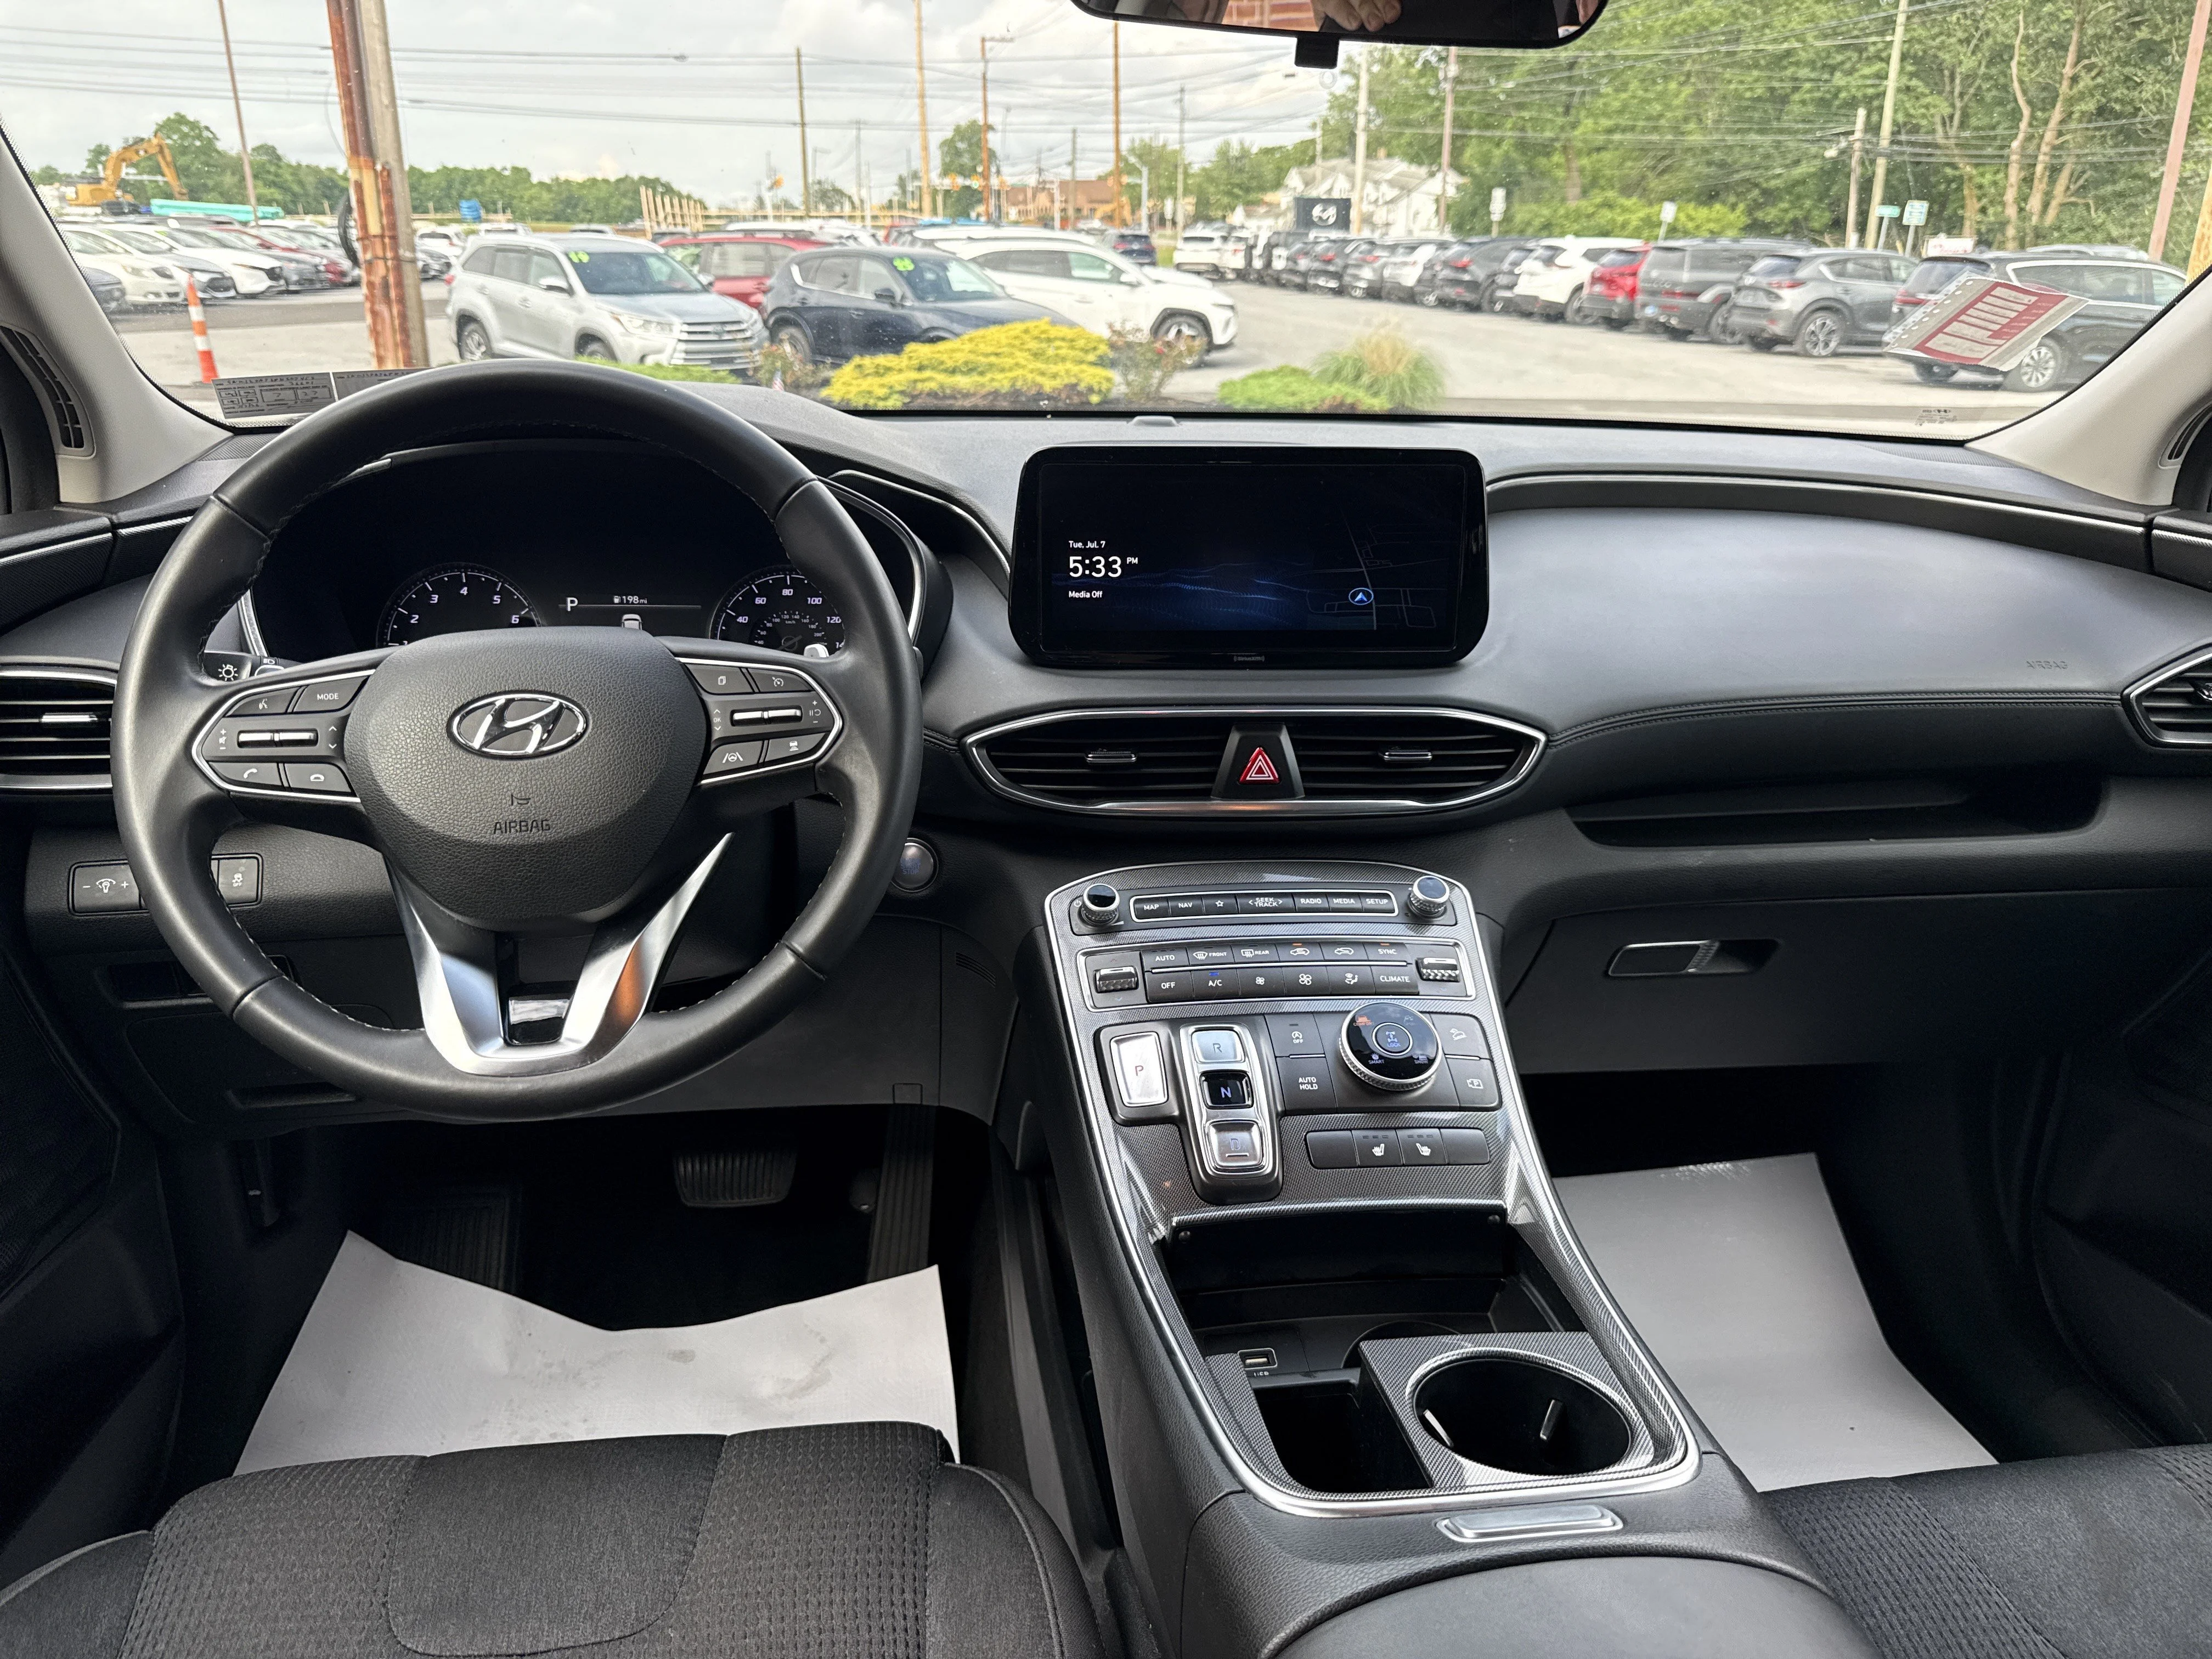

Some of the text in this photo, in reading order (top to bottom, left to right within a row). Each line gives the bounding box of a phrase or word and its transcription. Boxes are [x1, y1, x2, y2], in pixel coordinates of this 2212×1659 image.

[1068, 540, 1085, 549] Tue,
[1069, 556, 1122, 578] 5:33
[460, 586, 468, 595] 4
[430, 594, 438, 603] 3
[493, 595, 501, 604] 5
[567, 597, 578, 612] P
[410, 614, 419, 623] 2
[511, 615, 520, 624] 6
[2026, 660, 2068, 670] AIRBAG
[494, 819, 551, 834] AIRBAG
[1212, 1043, 1222, 1053] R
[1135, 1065, 1144, 1076] P
[1221, 1087, 1232, 1098] N
[1229, 1138, 1241, 1150] D
